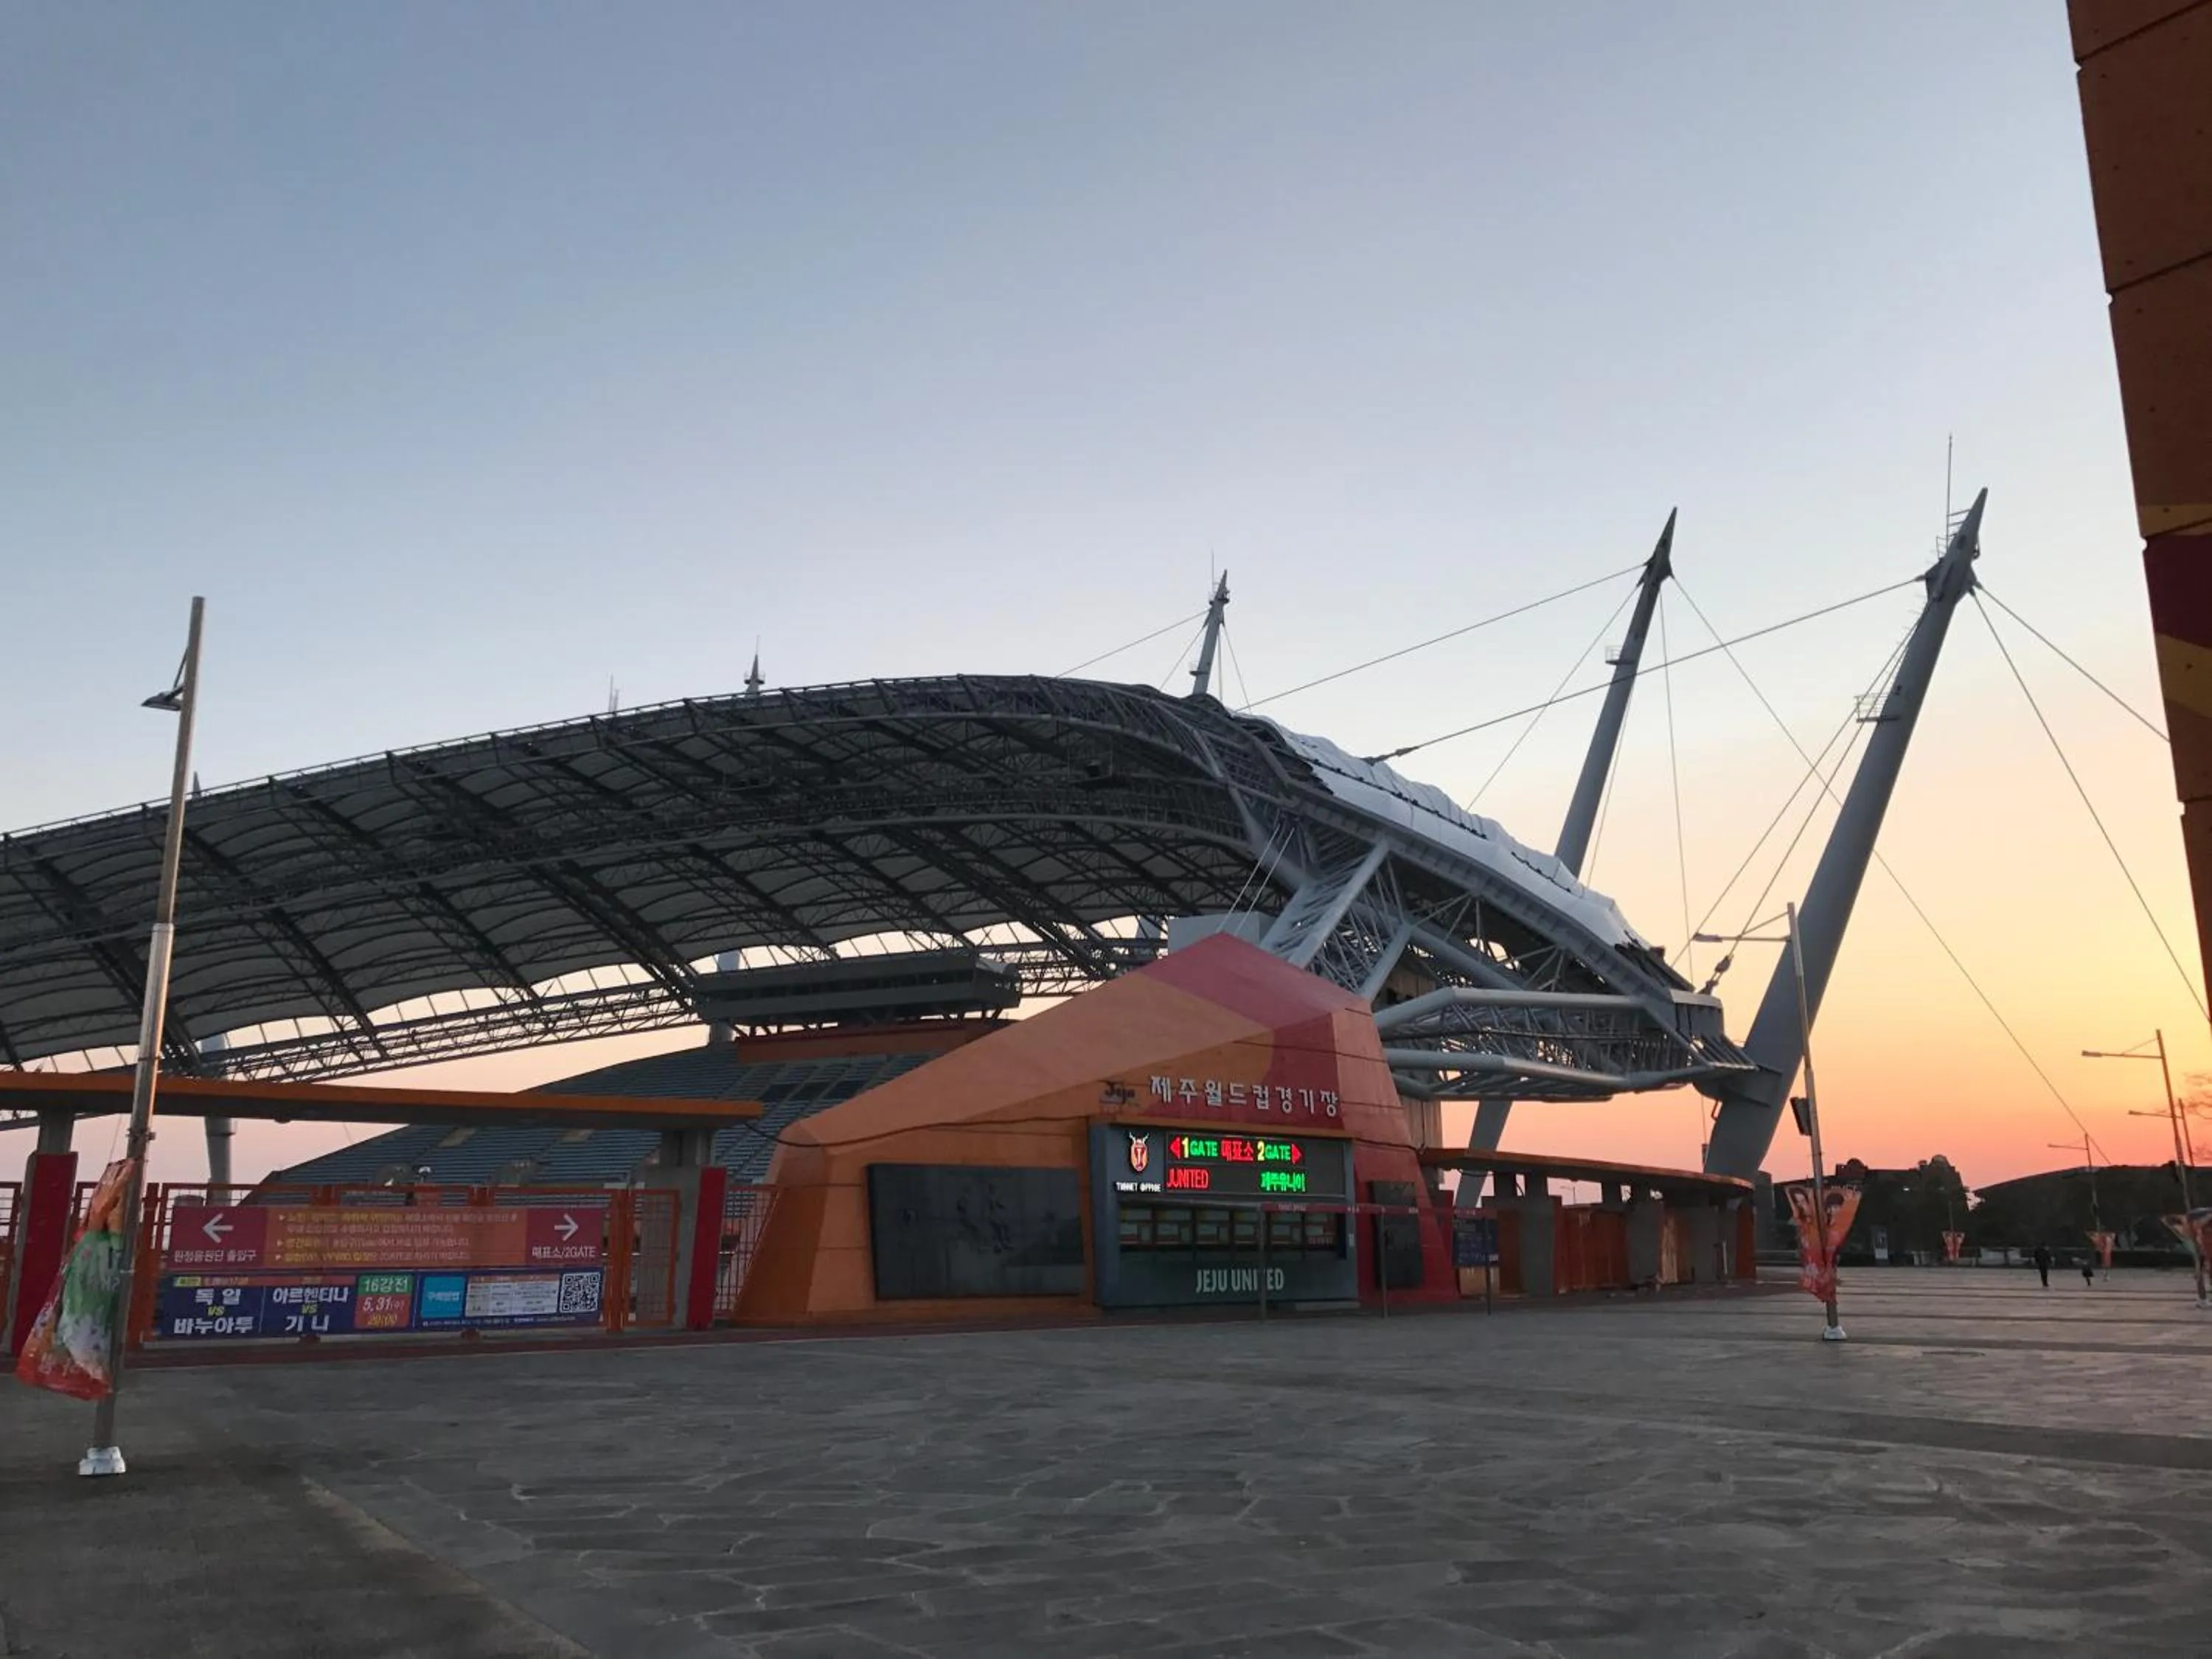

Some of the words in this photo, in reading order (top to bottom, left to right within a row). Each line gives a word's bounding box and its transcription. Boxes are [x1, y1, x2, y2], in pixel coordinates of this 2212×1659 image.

[1150, 1076, 1339, 1117] 제주월드컵경기장
[1221, 1138, 1253, 1161] 매표소
[364, 1276, 408, 1293] 16강전
[1195, 1268, 1228, 1294] JEJU
[1230, 1267, 1285, 1293] UNIED
[272, 1286, 349, 1304] 아르헨티나
[173, 1315, 254, 1335] 바누아투
